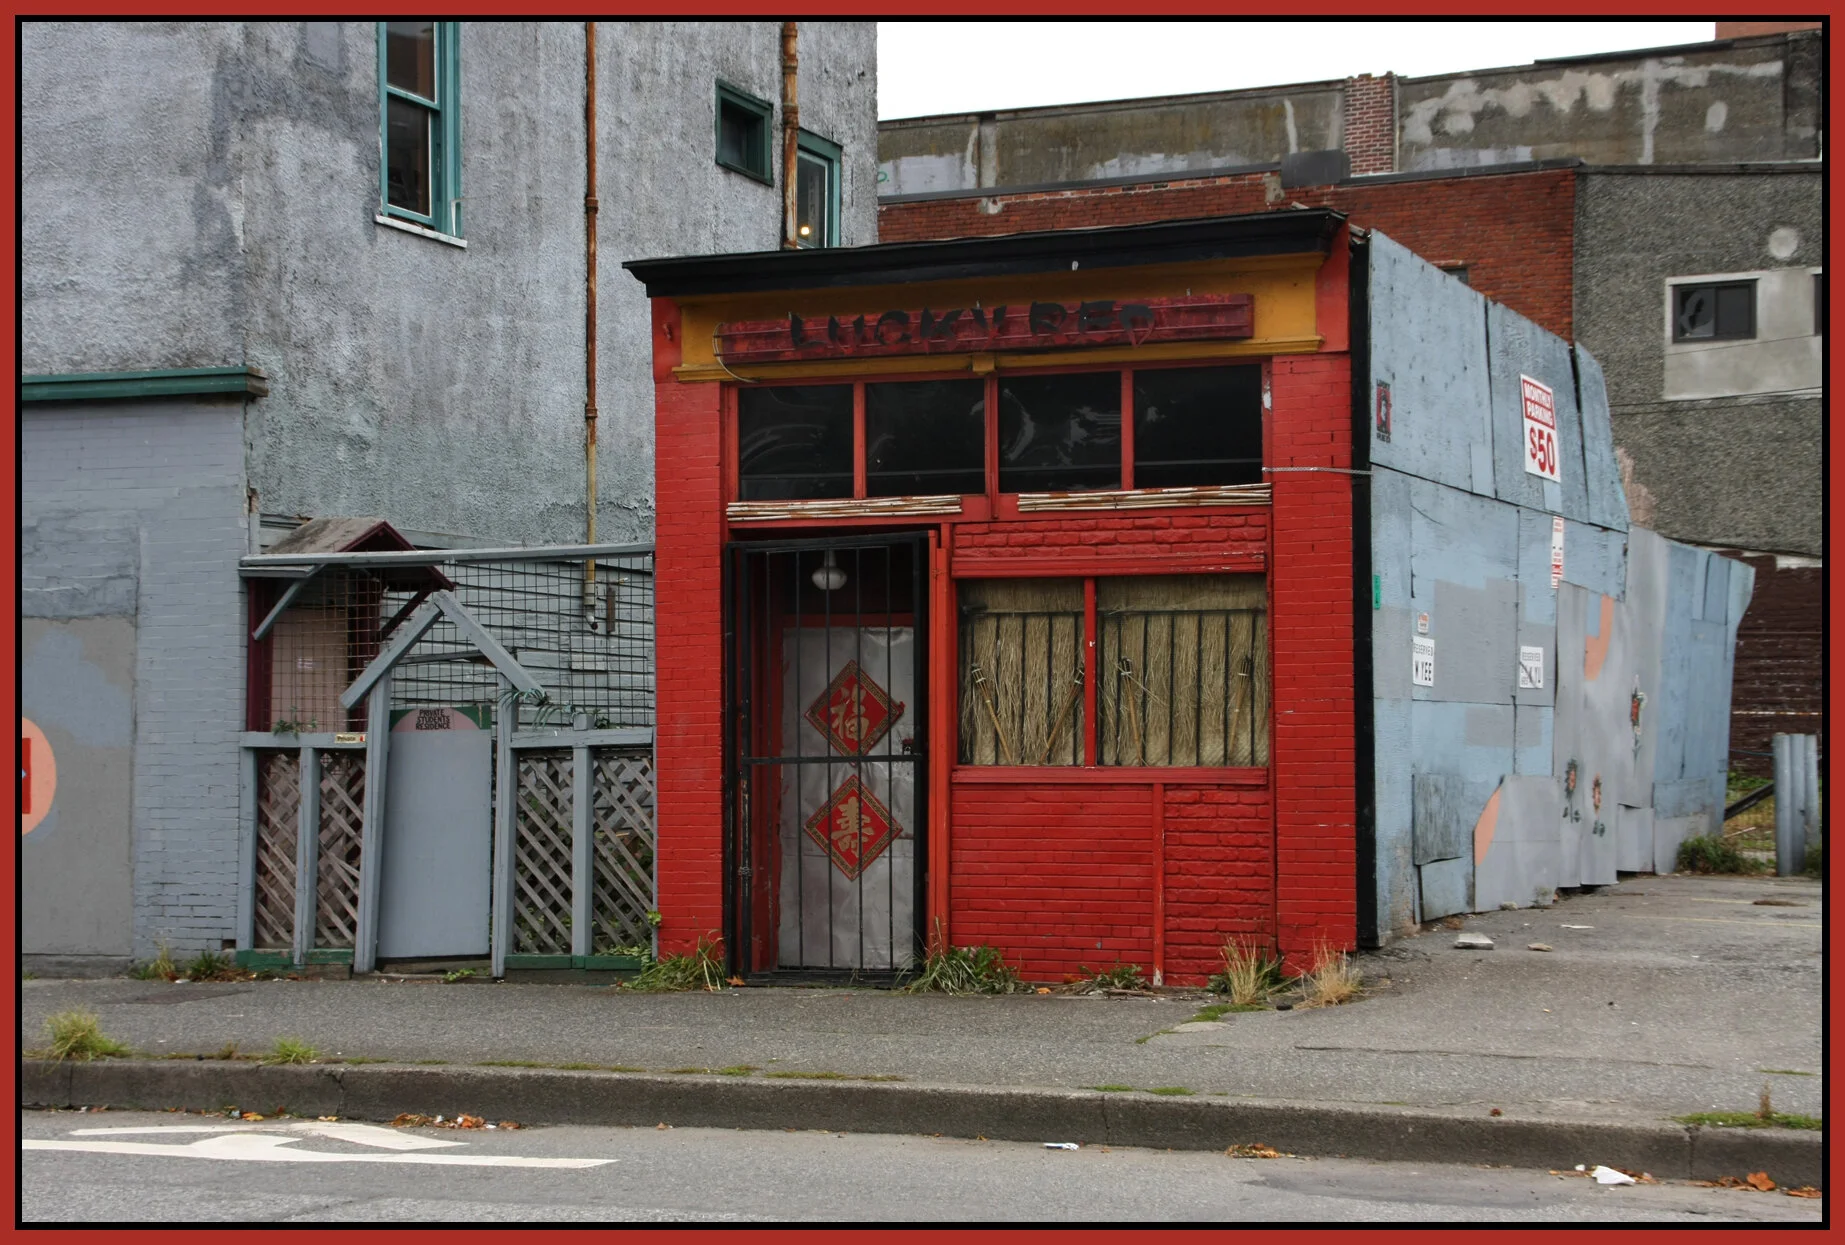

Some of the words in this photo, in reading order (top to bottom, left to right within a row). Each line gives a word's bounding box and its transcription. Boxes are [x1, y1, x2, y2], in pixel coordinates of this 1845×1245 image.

[789, 304, 1007, 354] LUCKY
[1029, 300, 1155, 348] RED
[1524, 382, 1552, 409] MONTHLY
[1526, 401, 1554, 426] PARKING
[1529, 424, 1556, 476] $50
[1413, 643, 1434, 657] RESERVED
[1421, 661, 1432, 682] YEE
[417, 716, 450, 724] STUDENTS
[419, 709, 445, 717] PRIVATE
[830, 683, 870, 741] 福
